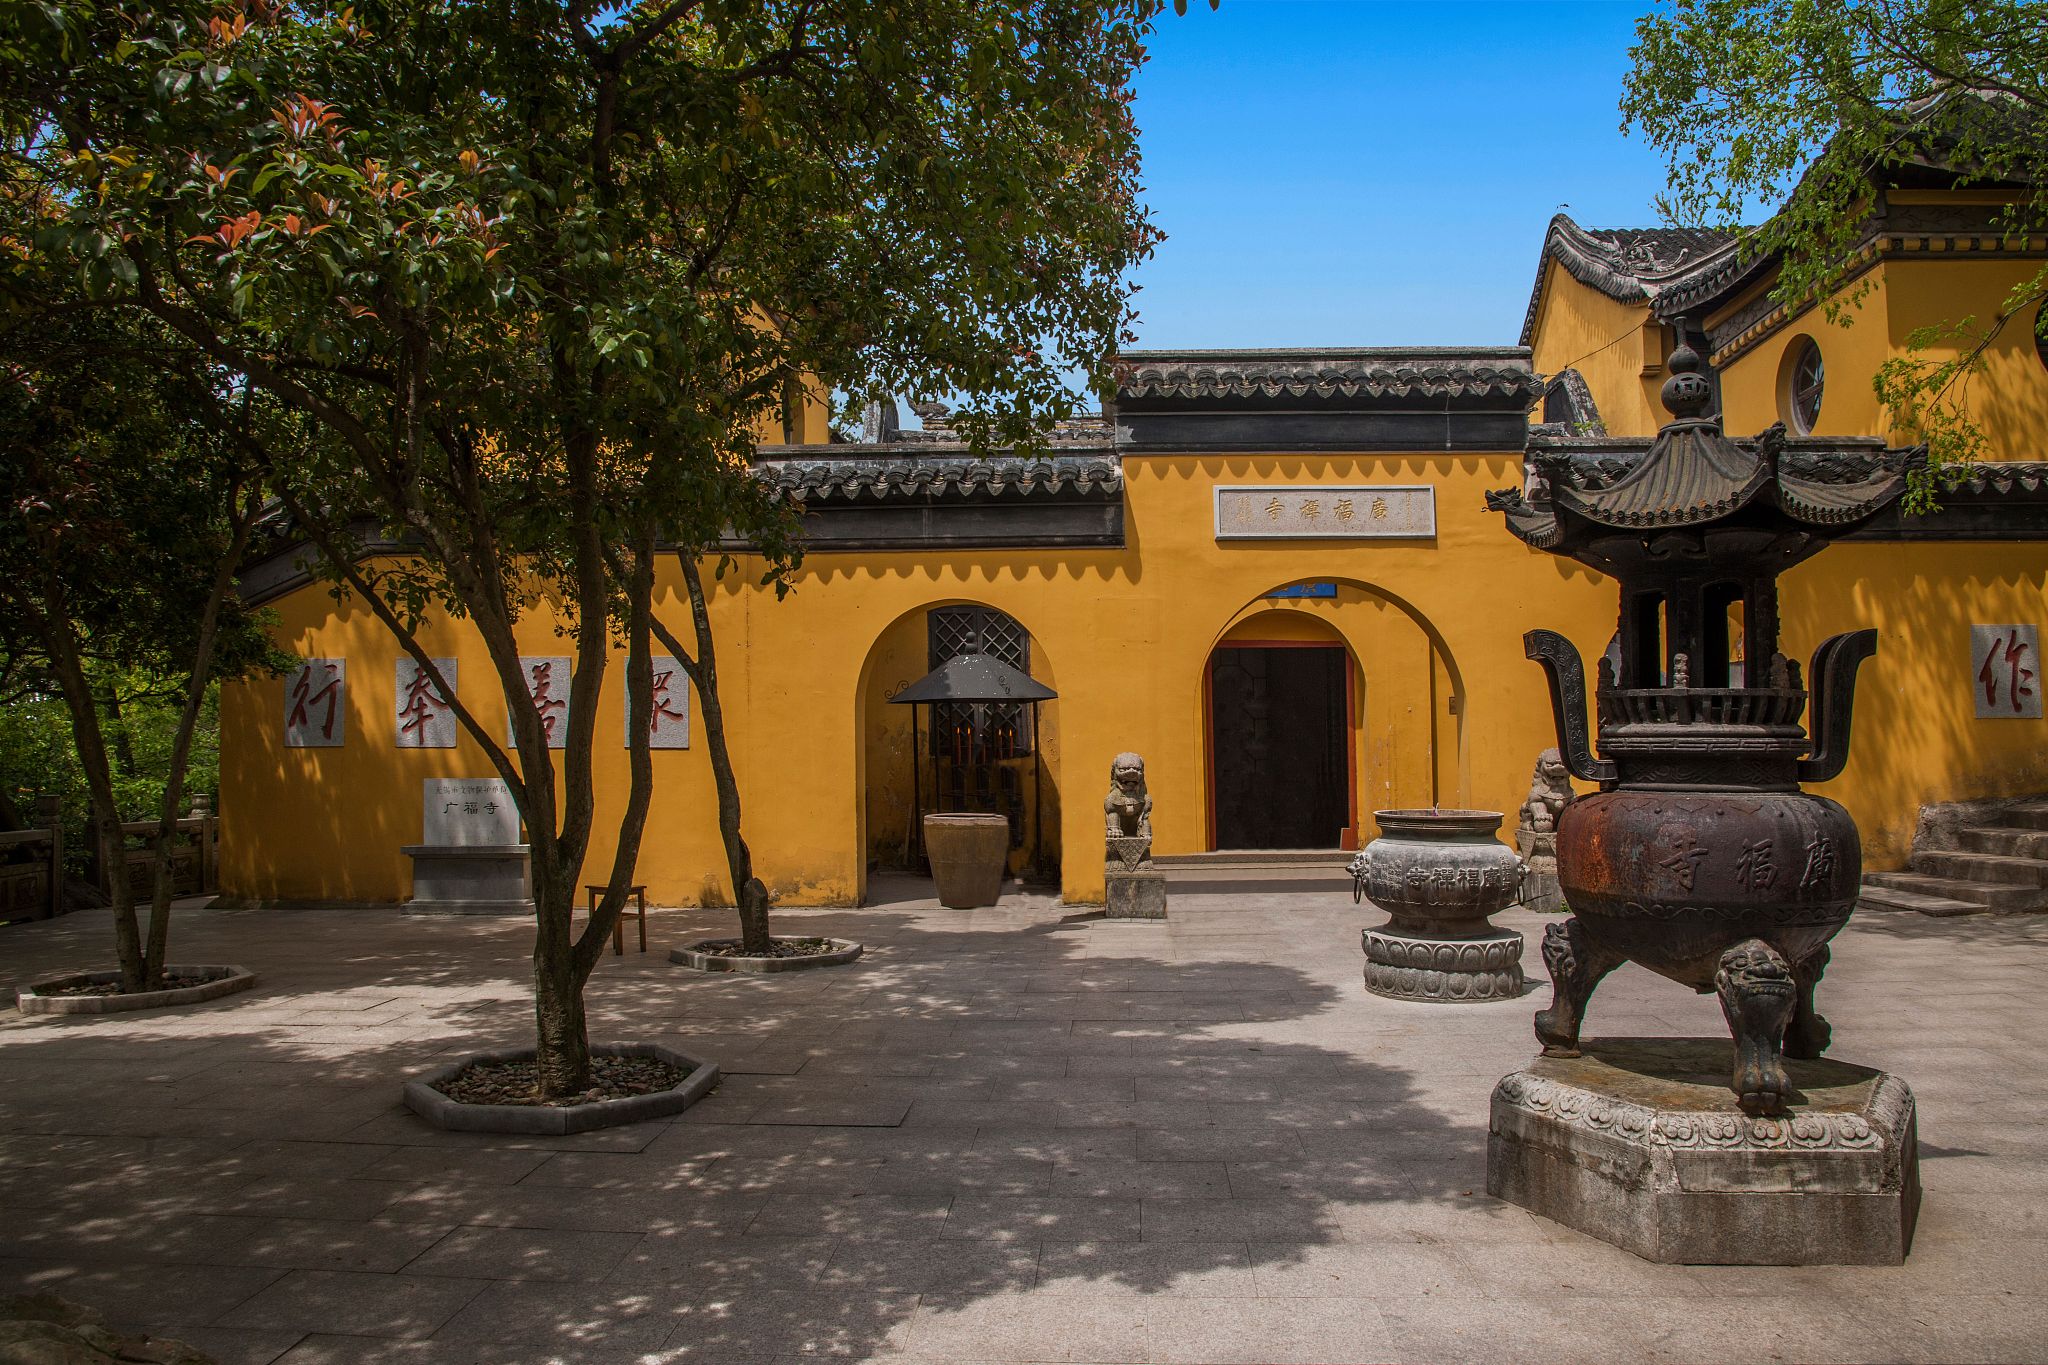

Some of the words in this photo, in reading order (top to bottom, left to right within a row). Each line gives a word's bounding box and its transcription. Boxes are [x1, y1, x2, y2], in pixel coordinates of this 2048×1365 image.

[288, 663, 341, 740] 行
[399, 665, 451, 746] 奉
[1979, 629, 2034, 713] 作
[442, 801, 500, 815] 广福寺
